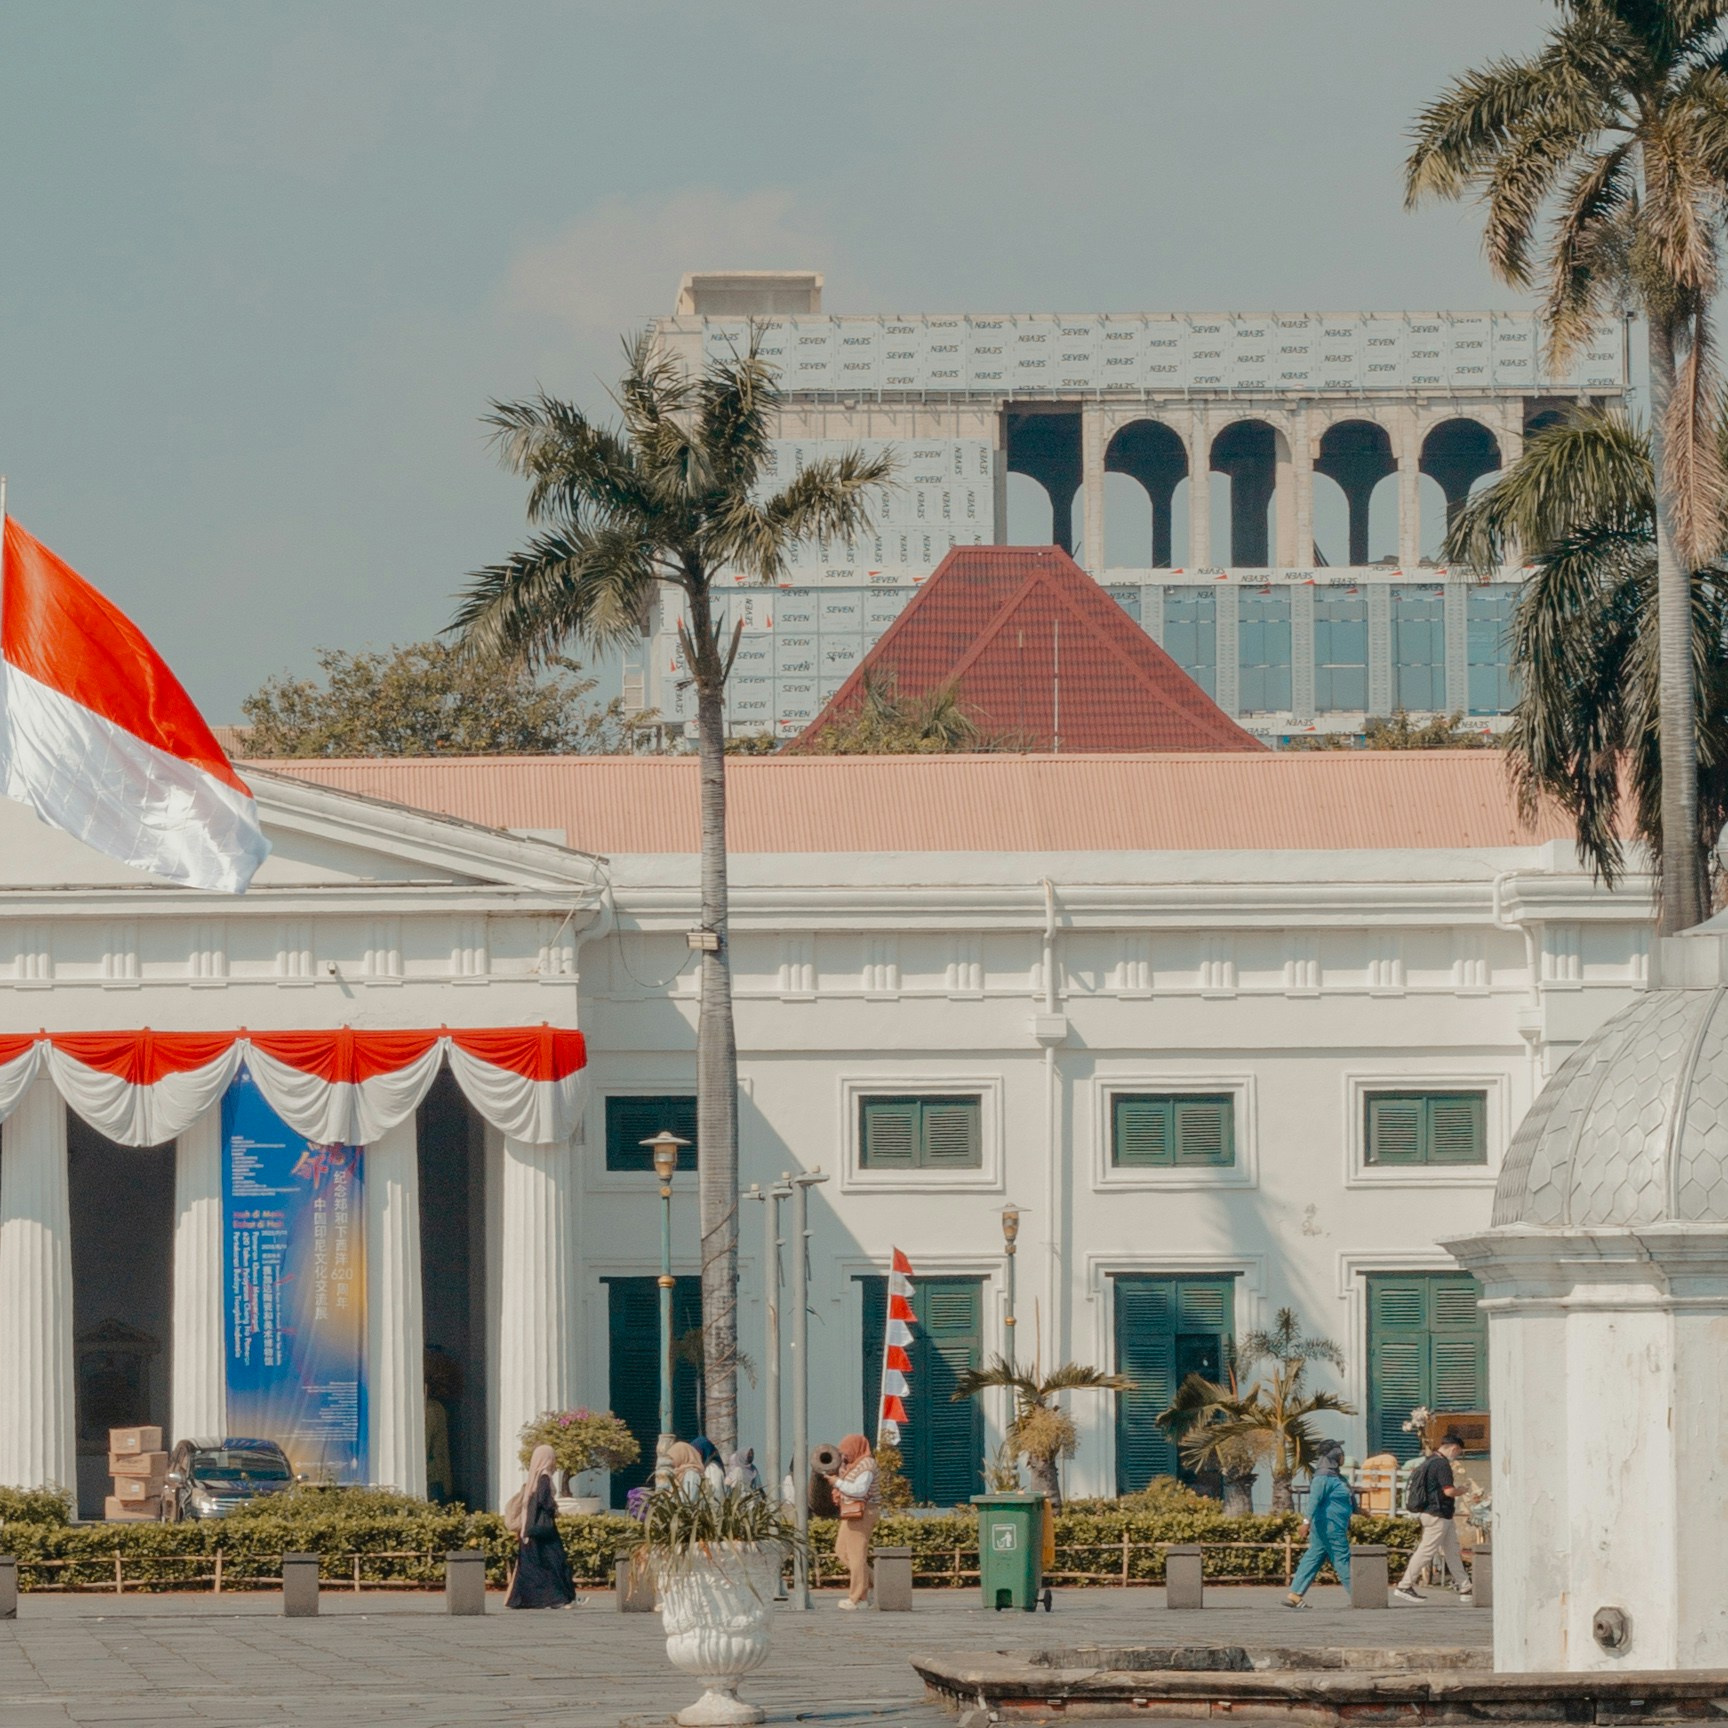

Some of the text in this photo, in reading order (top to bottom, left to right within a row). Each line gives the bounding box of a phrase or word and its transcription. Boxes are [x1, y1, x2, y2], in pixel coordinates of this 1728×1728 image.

[1105, 332, 1134, 340] SEVEN
[1193, 351, 1221, 359] SEVEN
[1194, 376, 1221, 384] SEVEN
[1324, 380, 1353, 388] SEVEN
[913, 451, 942, 459] SEVEN
[914, 476, 942, 484] SEVEN
[900, 535, 908, 563] SEVEN
[870, 576, 898, 584] SEVEN
[782, 589, 810, 597] SEVEN
[870, 589, 899, 597] SEVEN
[745, 599, 753, 626] SEVEN
[782, 639, 810, 647] SEVEN
[782, 685, 811, 693] SEVEN
[737, 701, 765, 709] SEVEN
[314, 1197, 328, 1320] 中国印尼文化交流展
